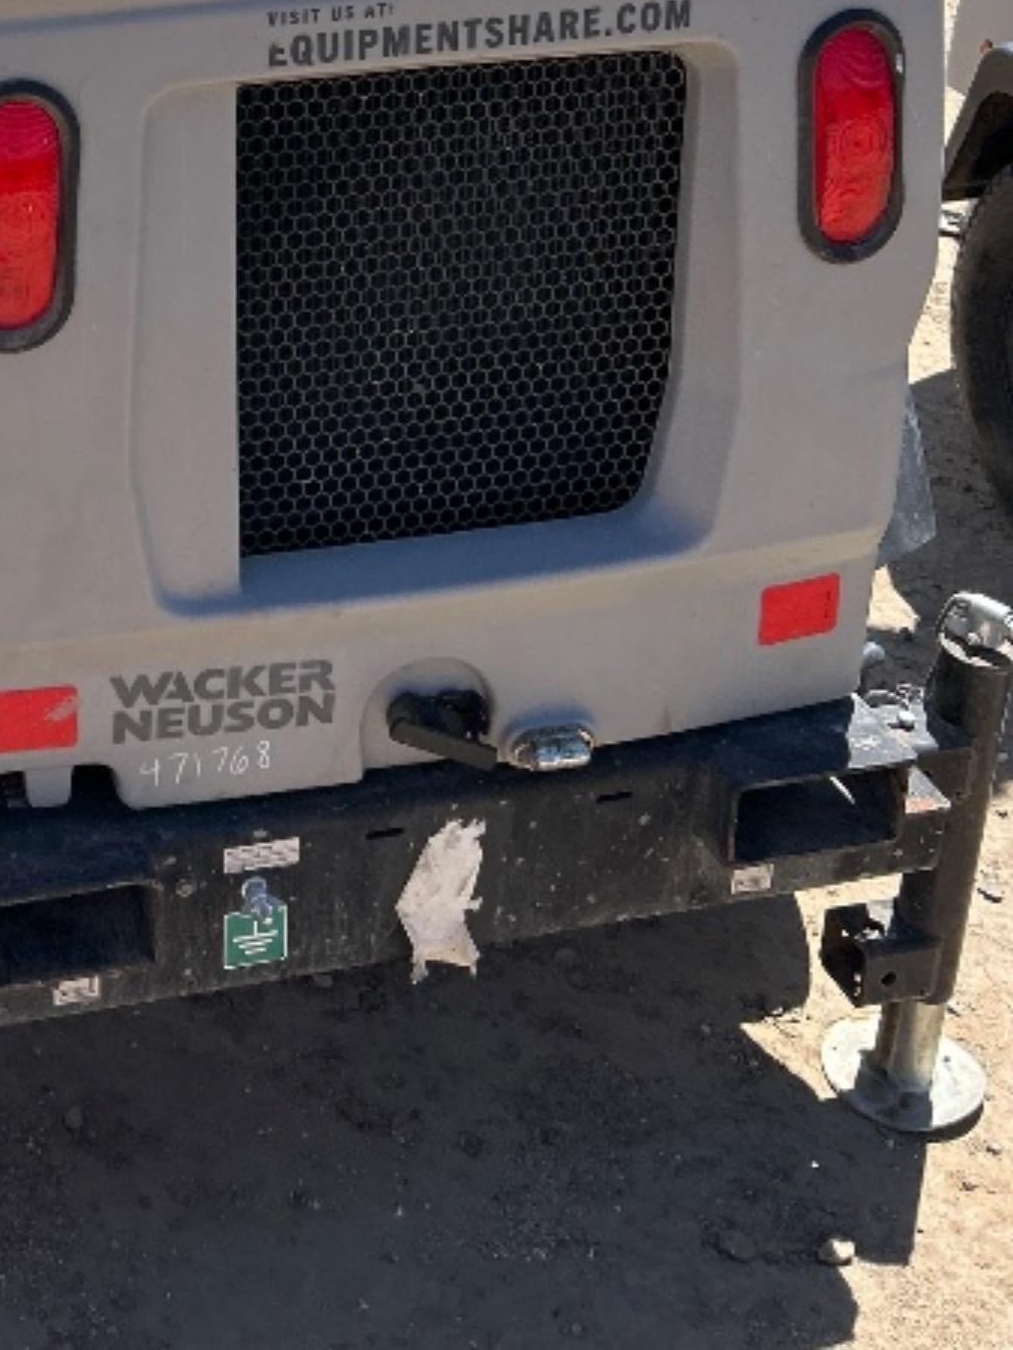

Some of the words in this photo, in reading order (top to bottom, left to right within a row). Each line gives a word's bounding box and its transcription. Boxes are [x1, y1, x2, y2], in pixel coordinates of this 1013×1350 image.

[267, 8, 321, 27] VISIT
[332, 5, 354, 22] US
[110, 659, 337, 709] WACKER
[112, 692, 336, 745] NEUSON
